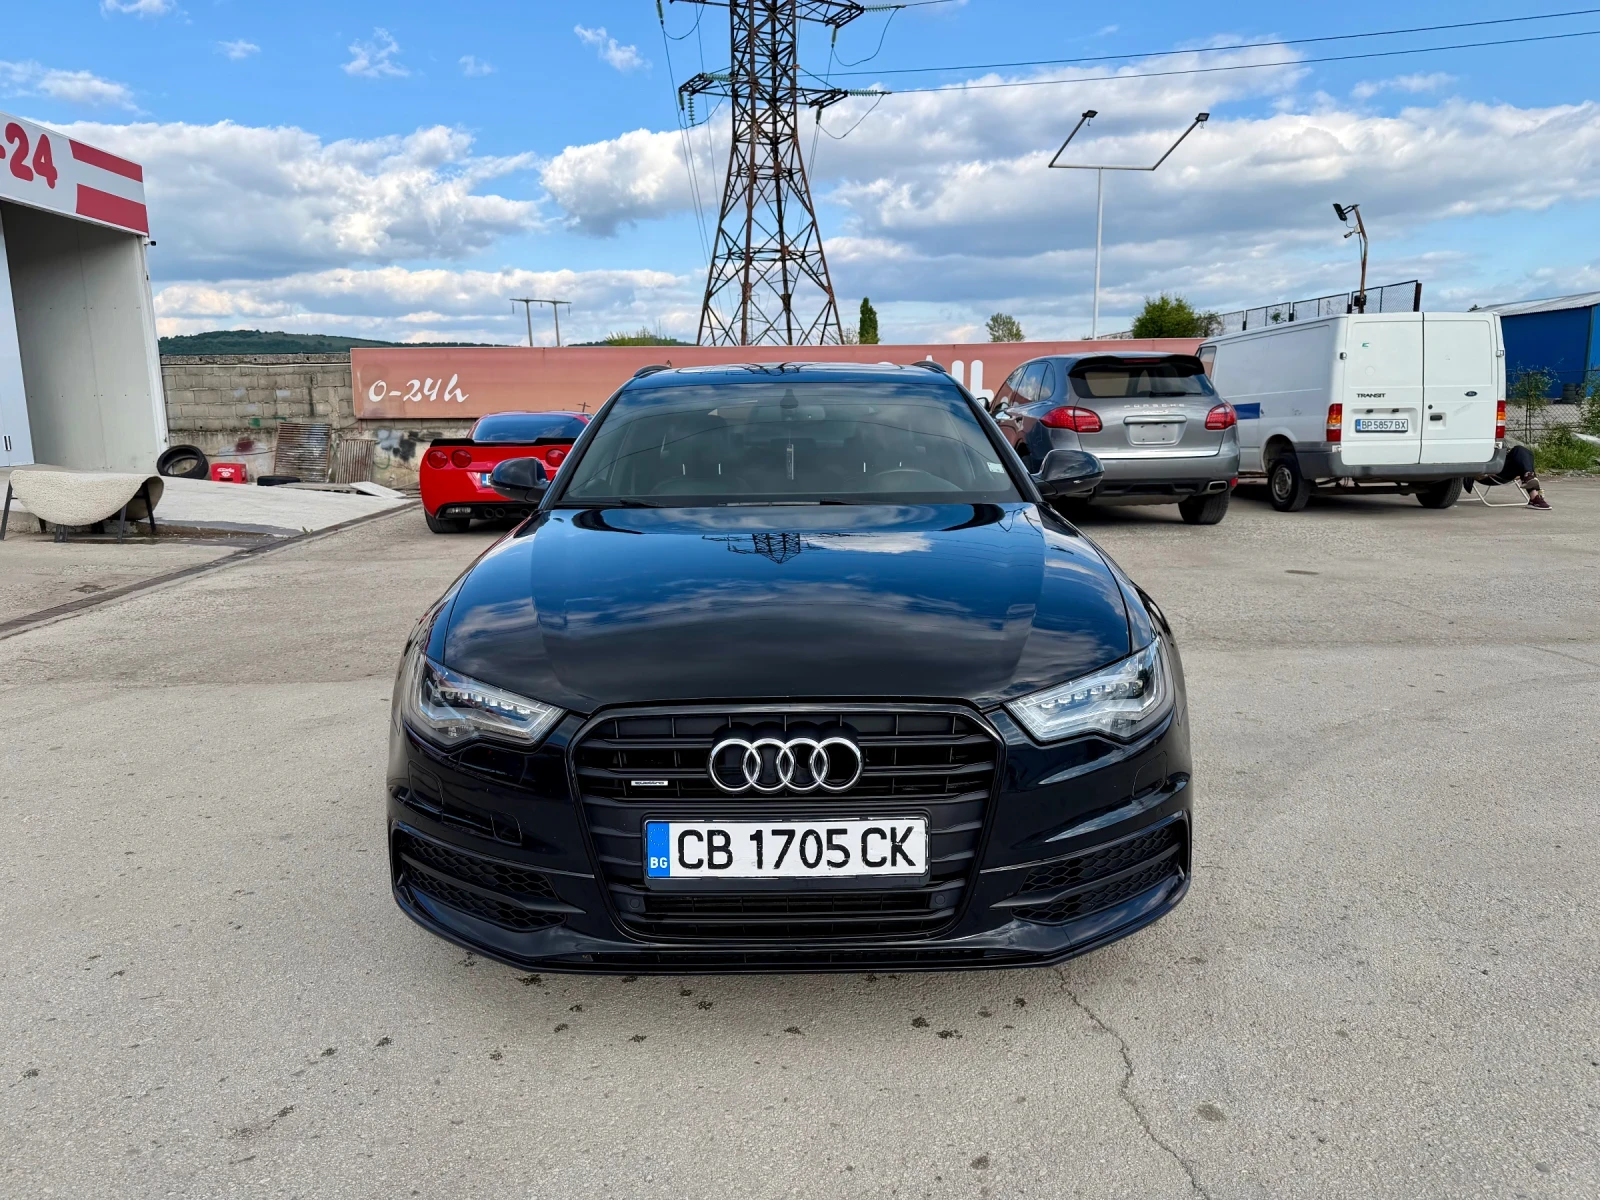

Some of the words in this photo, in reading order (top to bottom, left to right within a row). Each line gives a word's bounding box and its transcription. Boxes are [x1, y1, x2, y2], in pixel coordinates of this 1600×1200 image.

[368, 373, 469, 403] 0-24h
[1373, 420, 1394, 430] 5857
[1394, 420, 1407, 430] BX
[677, 829, 734, 869] CB
[749, 828, 851, 870] 1705
[860, 826, 917, 868] CK
[649, 857, 668, 869] BG
